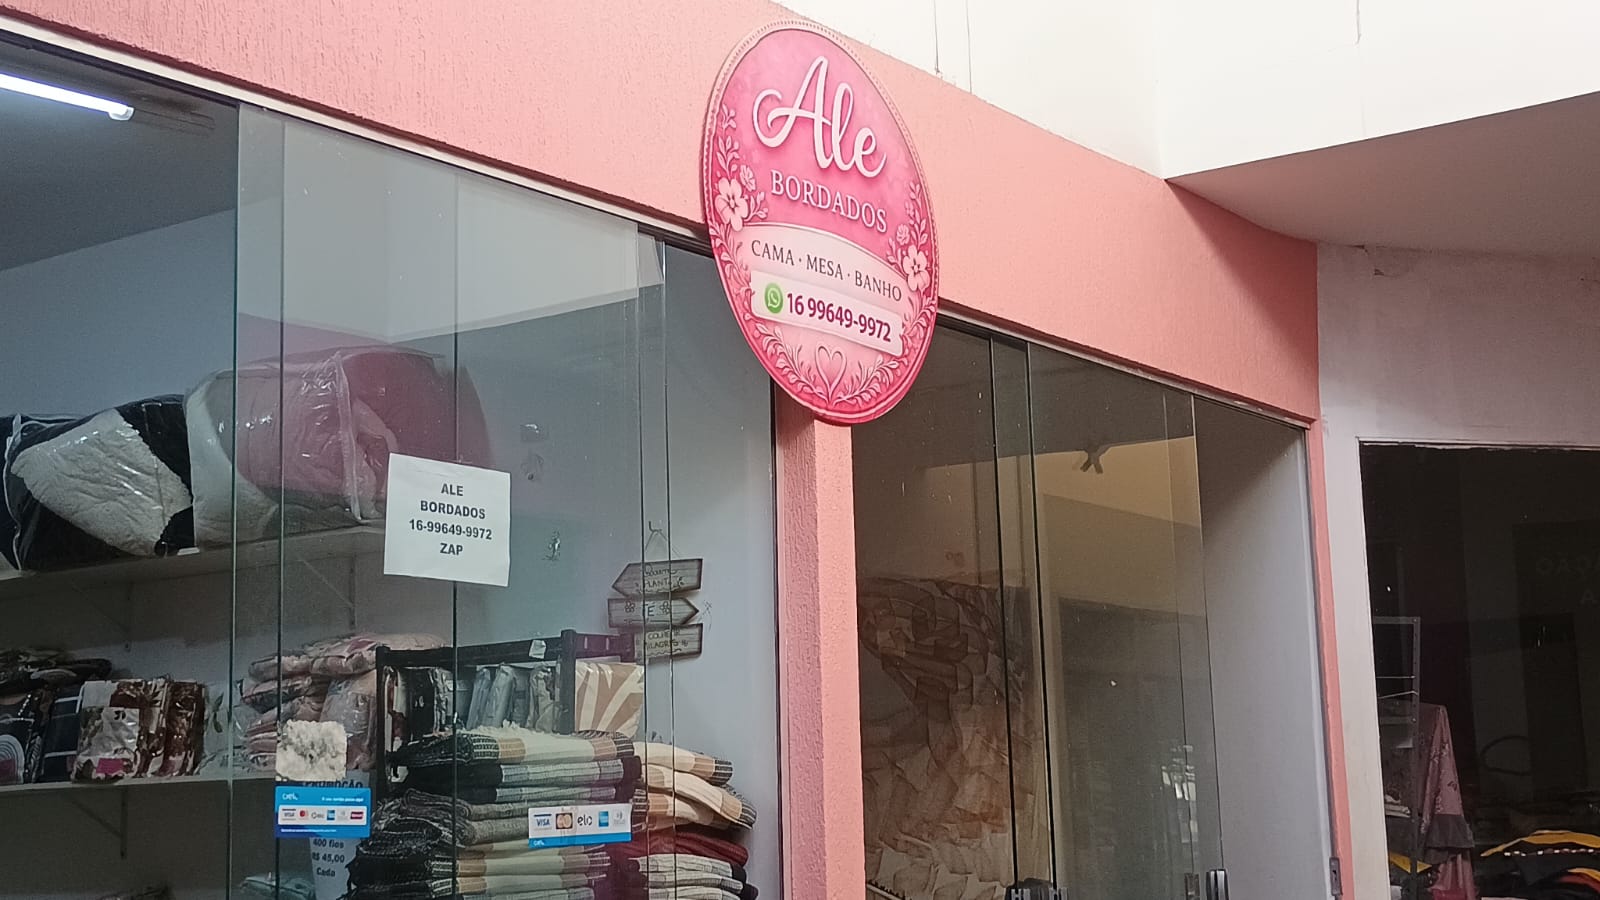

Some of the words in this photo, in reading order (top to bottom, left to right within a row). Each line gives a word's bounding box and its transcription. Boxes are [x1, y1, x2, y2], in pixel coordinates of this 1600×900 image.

[752, 54, 887, 178] Ale
[770, 168, 888, 234] BORDADOS
[751, 239, 795, 266] CAMA
[806, 254, 844, 281] MESA
[855, 270, 903, 302] BANHO
[787, 292, 805, 316] 16
[807, 297, 892, 343] 99649-9972
[441, 483, 464, 497] ALE
[420, 500, 486, 520] BORDADOS
[409, 518, 493, 540] 16-99649-9972
[440, 542, 464, 556] ZAP
[536, 818, 551, 827] VISA
[577, 814, 593, 826] elo
[322, 853, 345, 864] 45,00
